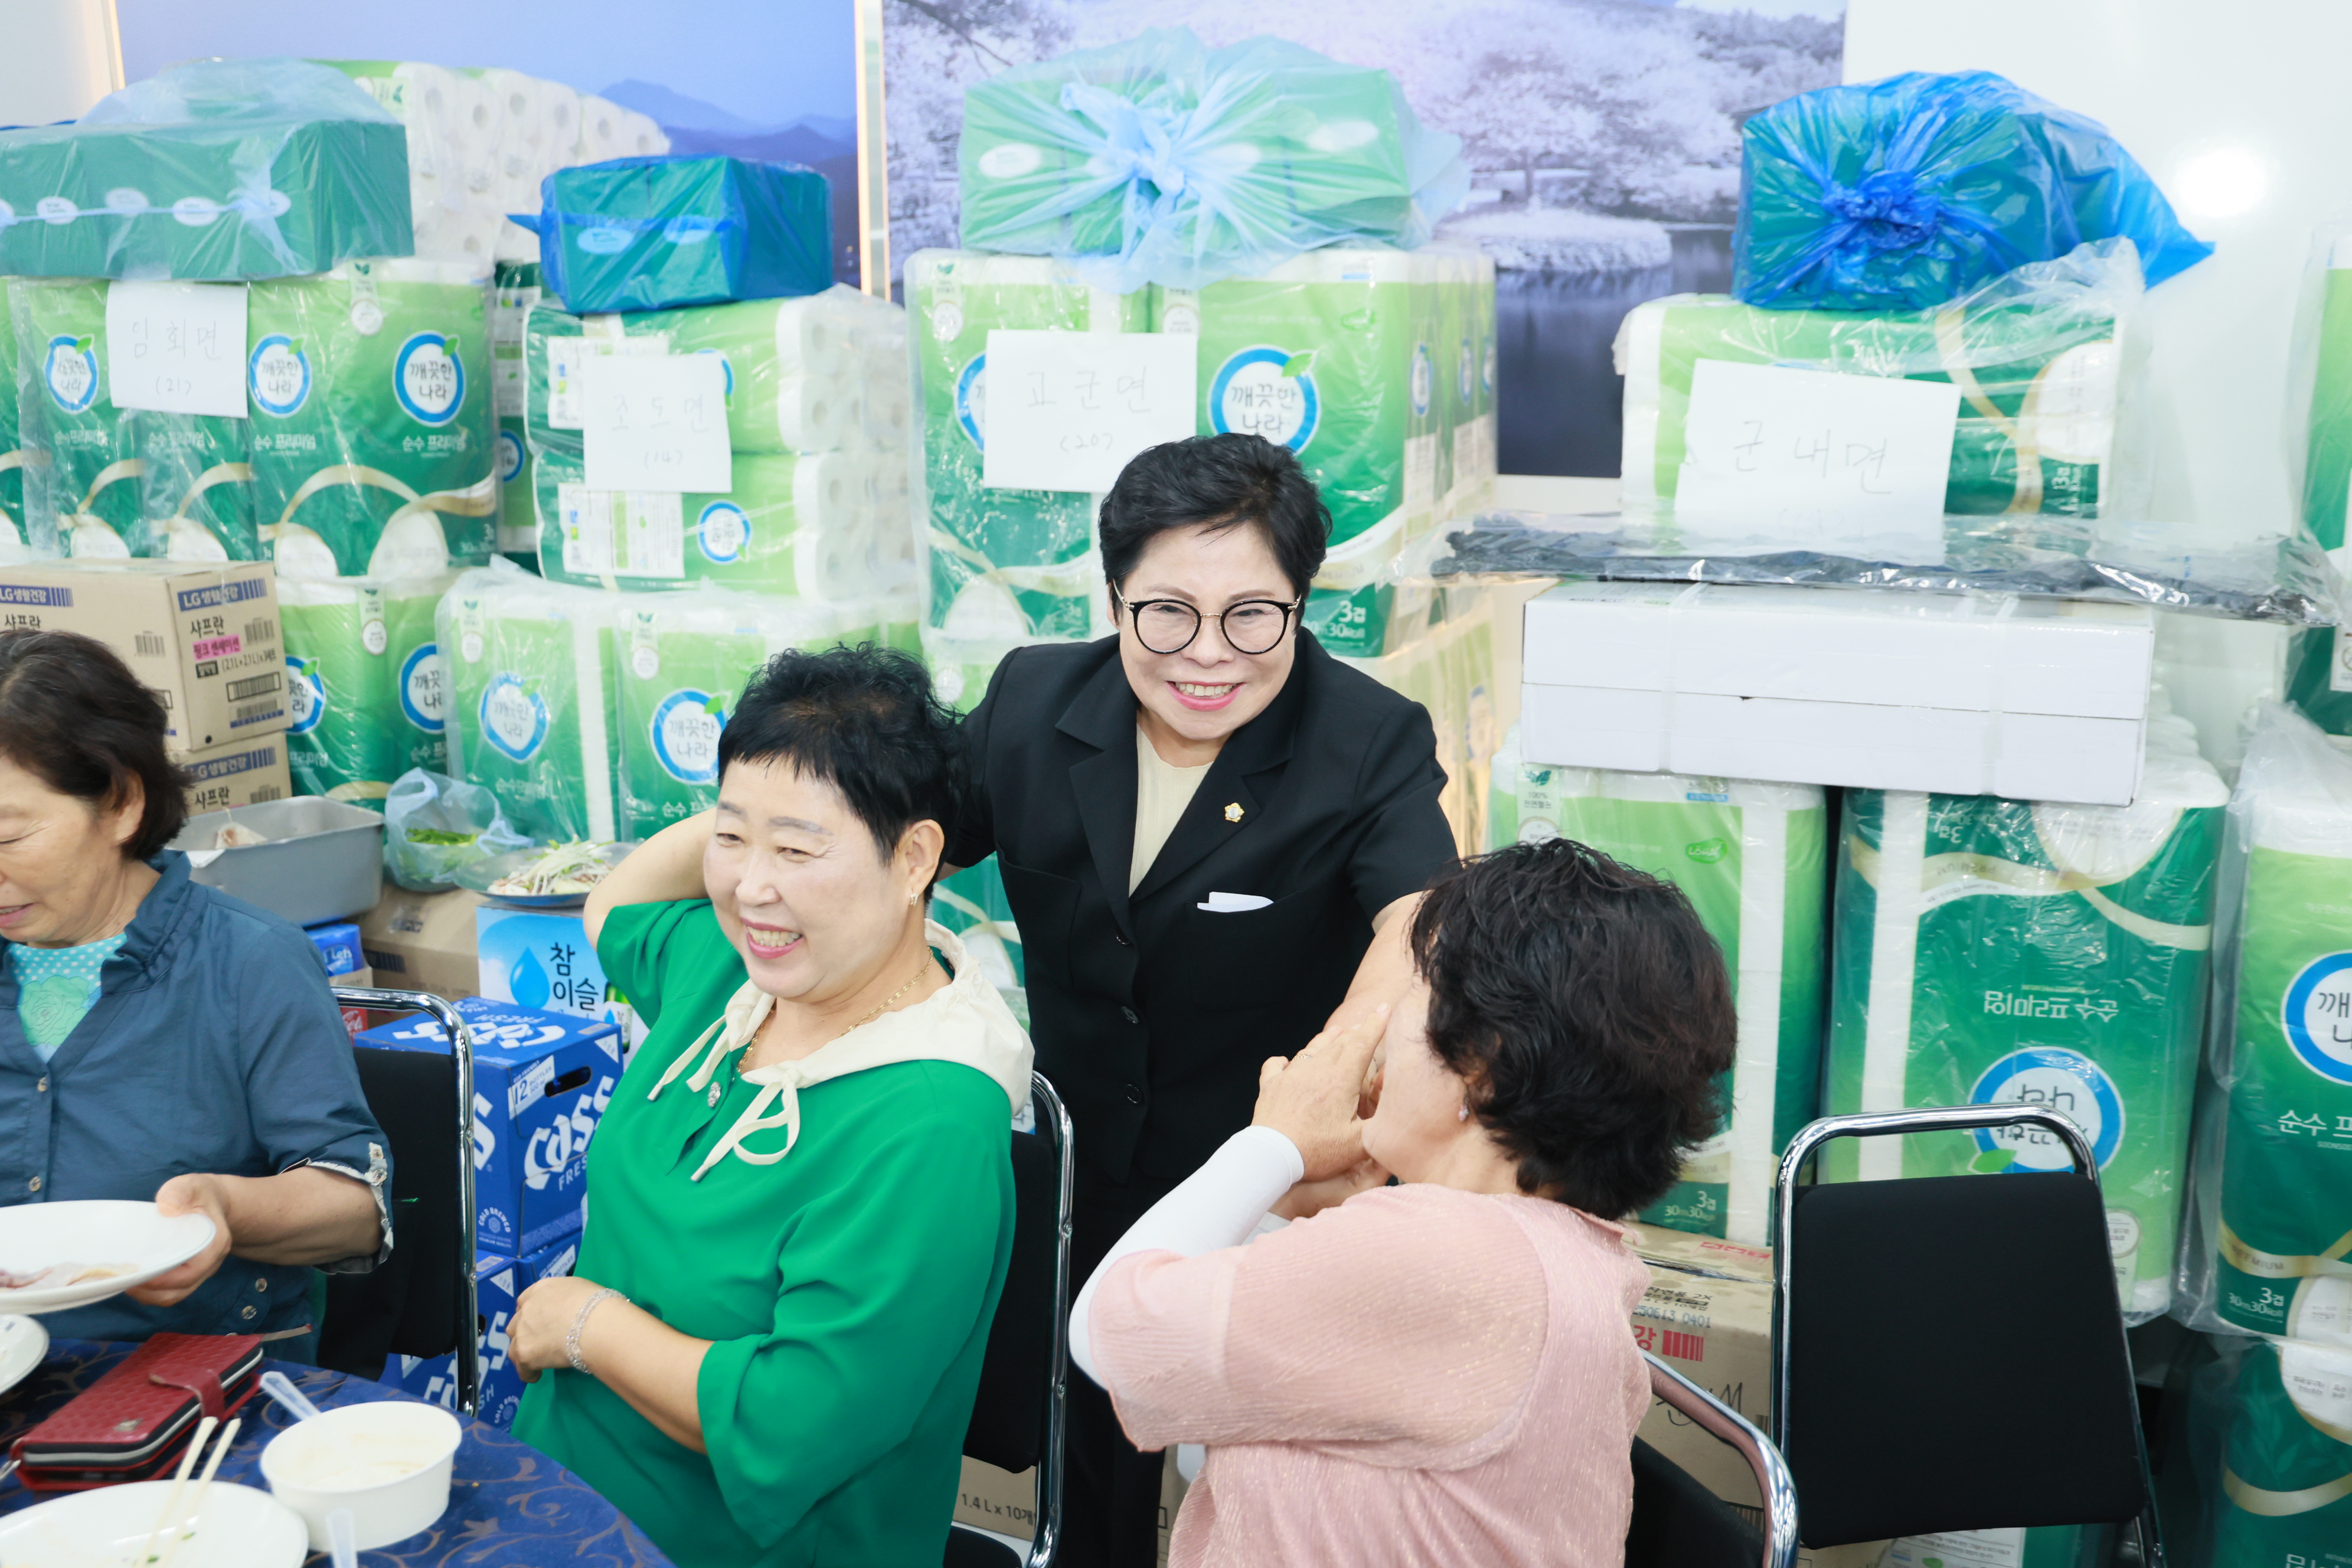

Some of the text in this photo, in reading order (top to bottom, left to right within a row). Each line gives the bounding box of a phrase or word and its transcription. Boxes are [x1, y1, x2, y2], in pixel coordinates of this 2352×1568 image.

[262, 358, 299, 378] 깨끗한
[410, 360, 453, 382] 깨끗한
[267, 379, 292, 395] 나라
[419, 384, 447, 400] 나라
[1231, 383, 1297, 410] 깨끗한
[1242, 412, 1285, 435] 나라
[191, 615, 225, 638] 샤프란
[414, 671, 440, 689] 깨끗
[292, 699, 306, 713] 라
[668, 718, 716, 739] 깨끗한
[677, 741, 708, 759] 나라
[197, 756, 248, 778] G생활건강
[195, 786, 230, 809] 샤프란
[550, 941, 576, 976] 참
[553, 978, 599, 1012] 이슬
[1984, 990, 2119, 1023] 순수 프리미엄
[514, 1065, 552, 1105] 12 BOTTLES
[2017, 1083, 2075, 1111] 나라
[2278, 1110, 2328, 1136] 순수
[558, 1154, 588, 1191] FRES
[478, 1206, 512, 1233] COLD BREWED
[2259, 1287, 2285, 1307] 3겹
[1683, 1312, 1711, 1329] 0401
[961, 1493, 1036, 1525] 1.4 L x 10개
